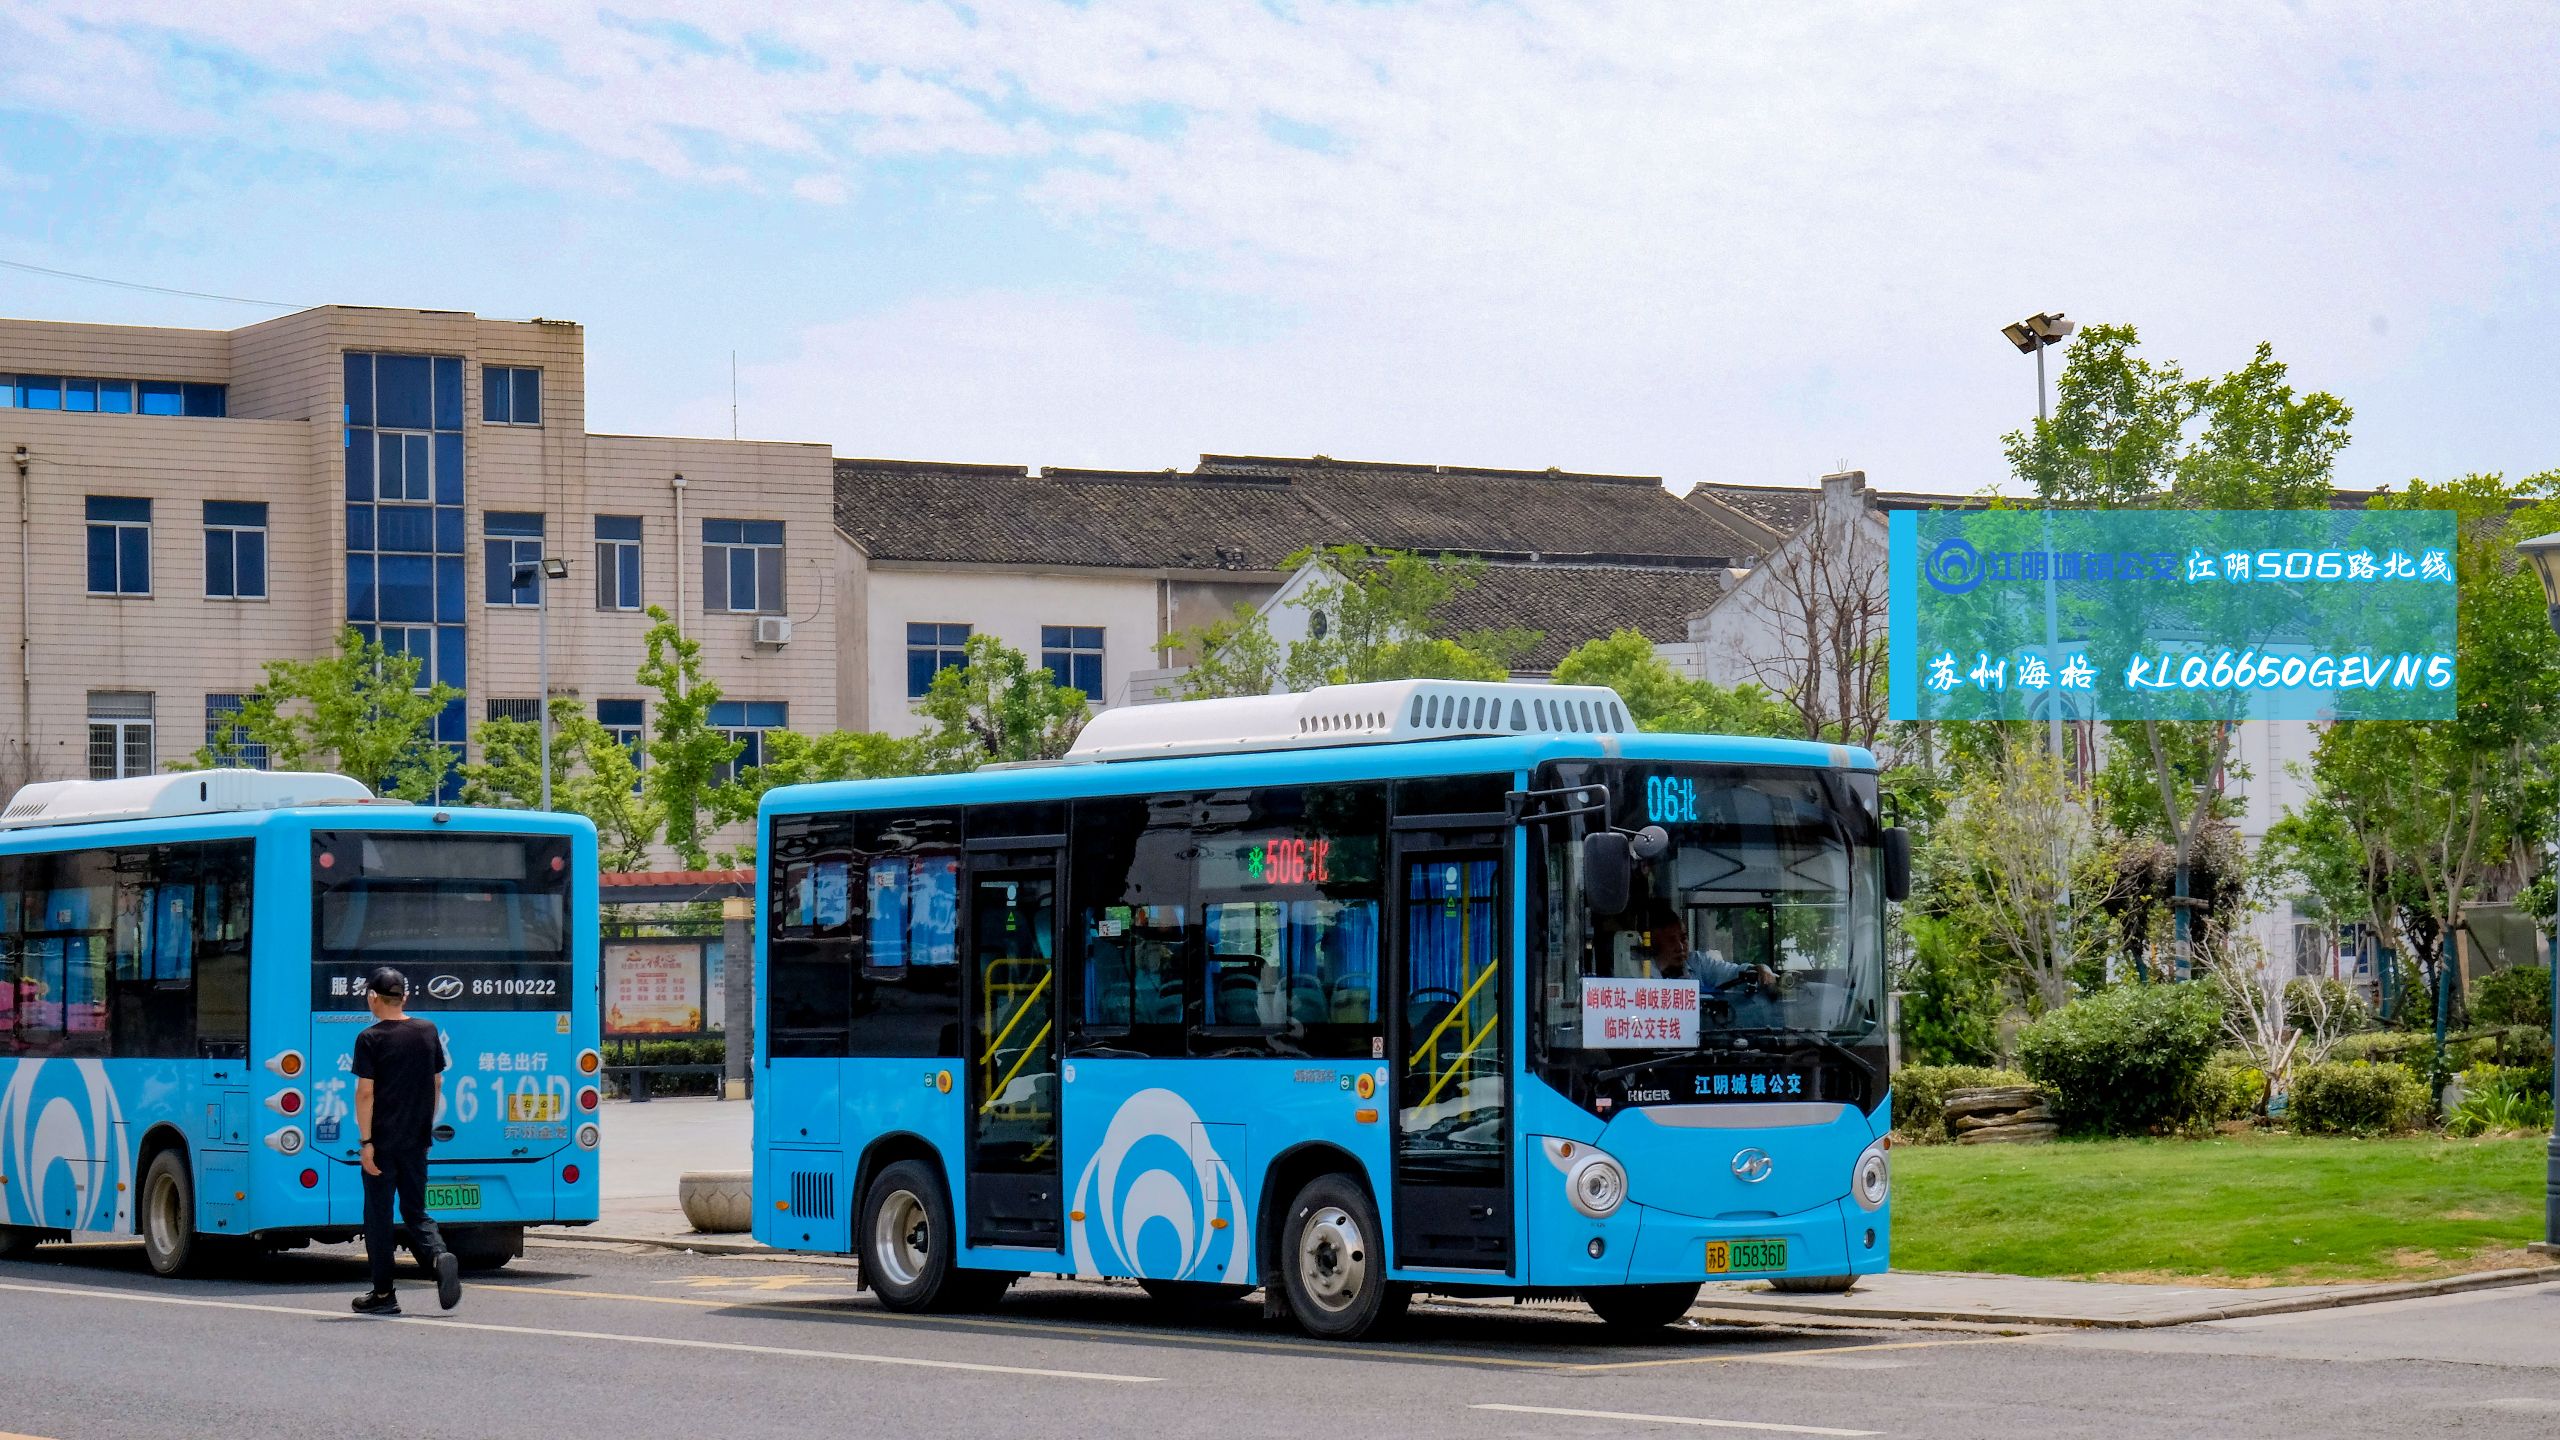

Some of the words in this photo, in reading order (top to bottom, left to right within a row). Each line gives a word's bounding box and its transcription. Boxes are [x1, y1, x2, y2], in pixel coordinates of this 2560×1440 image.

[472, 979, 556, 995] 86100222
[1604, 1016, 1681, 1040] 临时公交专线
[478, 1052, 548, 1071] 绿色出行
[1694, 1073, 1802, 1095] 江阴城镇公交
[1628, 1089, 1671, 1101] HIGER
[1708, 1247, 1726, 1268] 苏B
[1733, 1244, 1785, 1267] 05836D
